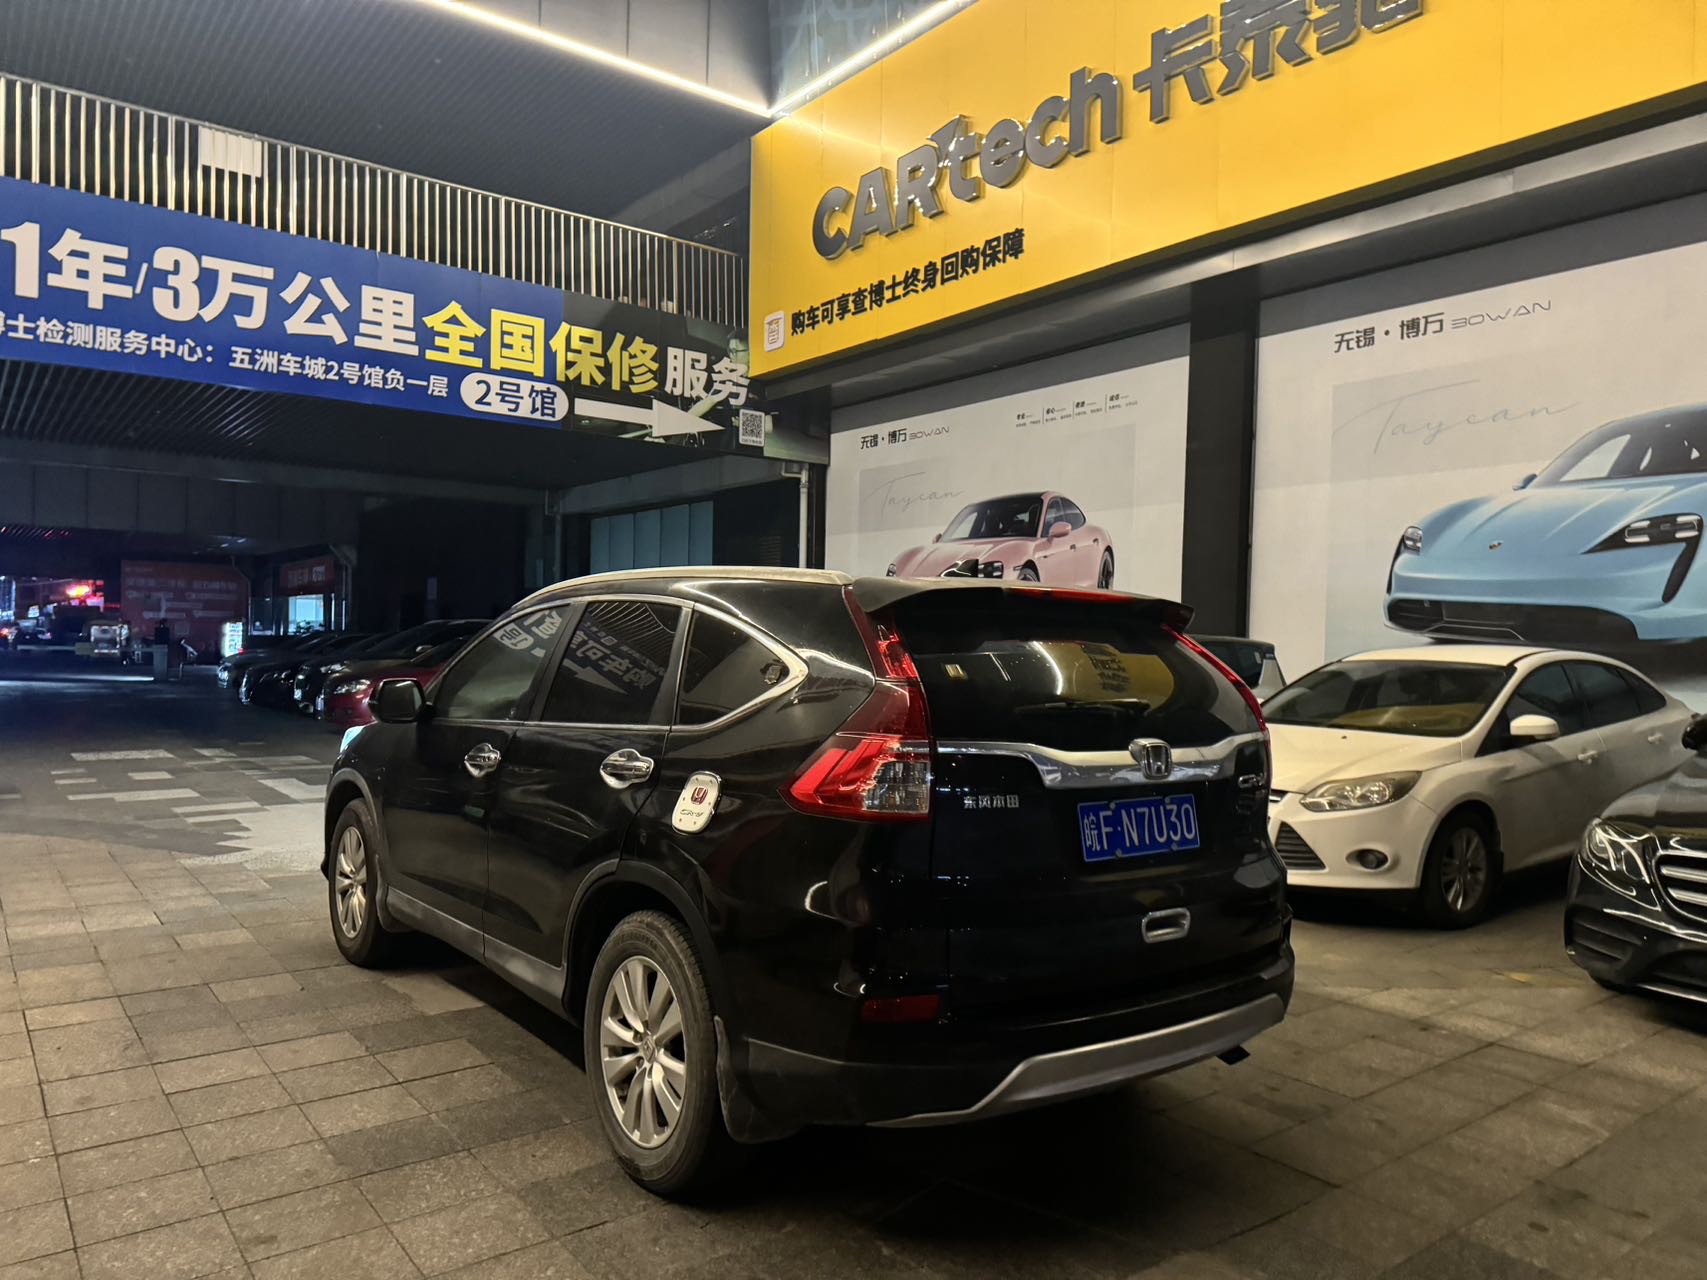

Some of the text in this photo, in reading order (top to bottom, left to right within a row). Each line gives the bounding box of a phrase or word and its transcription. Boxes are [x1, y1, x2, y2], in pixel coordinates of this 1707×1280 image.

[791, 228, 1025, 336] 购车可享查博士终身回购保障
[473, 378, 557, 419] 2号馆
[1332, 379, 1578, 456] Taycan
